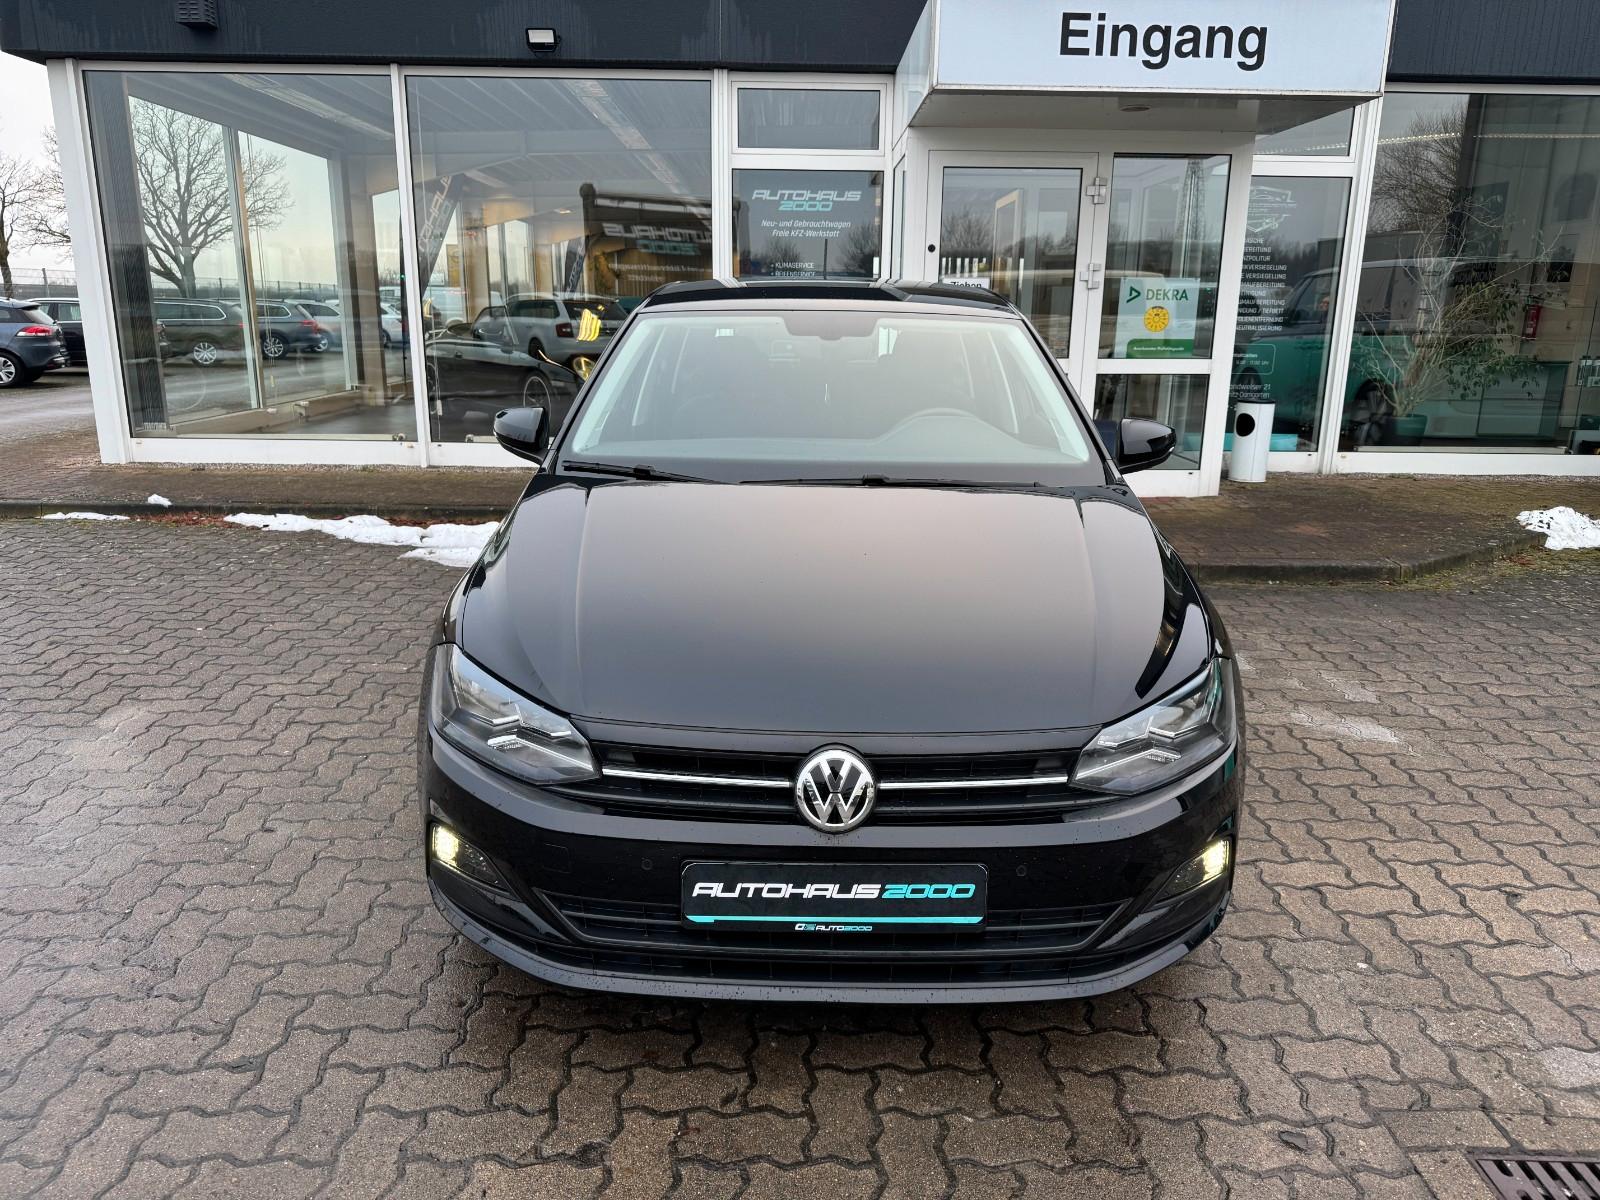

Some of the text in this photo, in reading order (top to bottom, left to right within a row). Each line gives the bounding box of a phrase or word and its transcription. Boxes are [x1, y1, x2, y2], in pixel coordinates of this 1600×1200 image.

[1060, 12, 1268, 71] Eingang
[752, 189, 862, 201] AUTOHAUS
[778, 201, 833, 212] 2000
[794, 220, 851, 229] Gebrauchtwagen
[772, 229, 840, 238] Freie KFZ-Werkstatt
[1146, 288, 1189, 300] DEKRA
[692, 882, 976, 899] AUTOHAUS 2000
